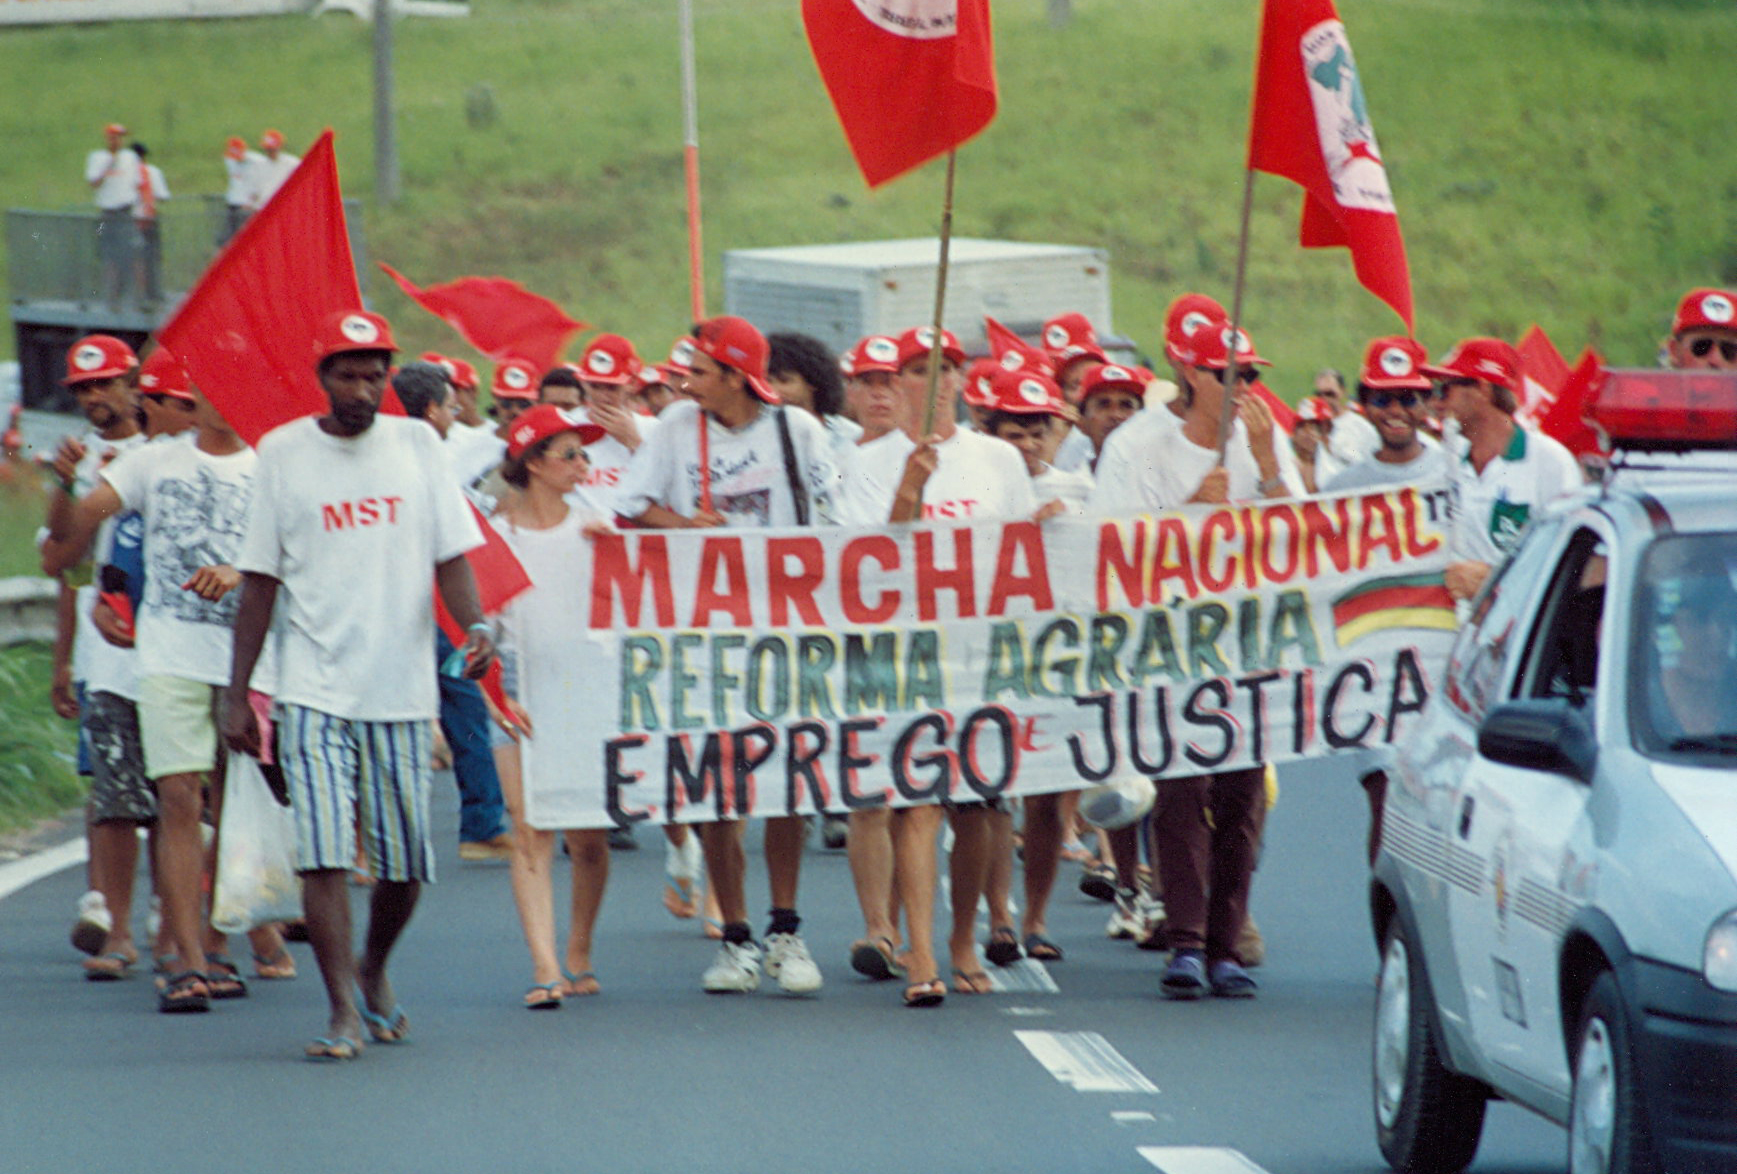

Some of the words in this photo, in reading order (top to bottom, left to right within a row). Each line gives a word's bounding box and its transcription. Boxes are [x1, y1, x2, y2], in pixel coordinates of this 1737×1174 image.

[321, 496, 402, 532] MST
[589, 521, 1055, 629] MARCHA
[1095, 486, 1443, 612] NACIONAL
[618, 628, 951, 732] REFORMA
[605, 704, 1021, 825] EMPREGO
[1021, 714, 1057, 752] E
